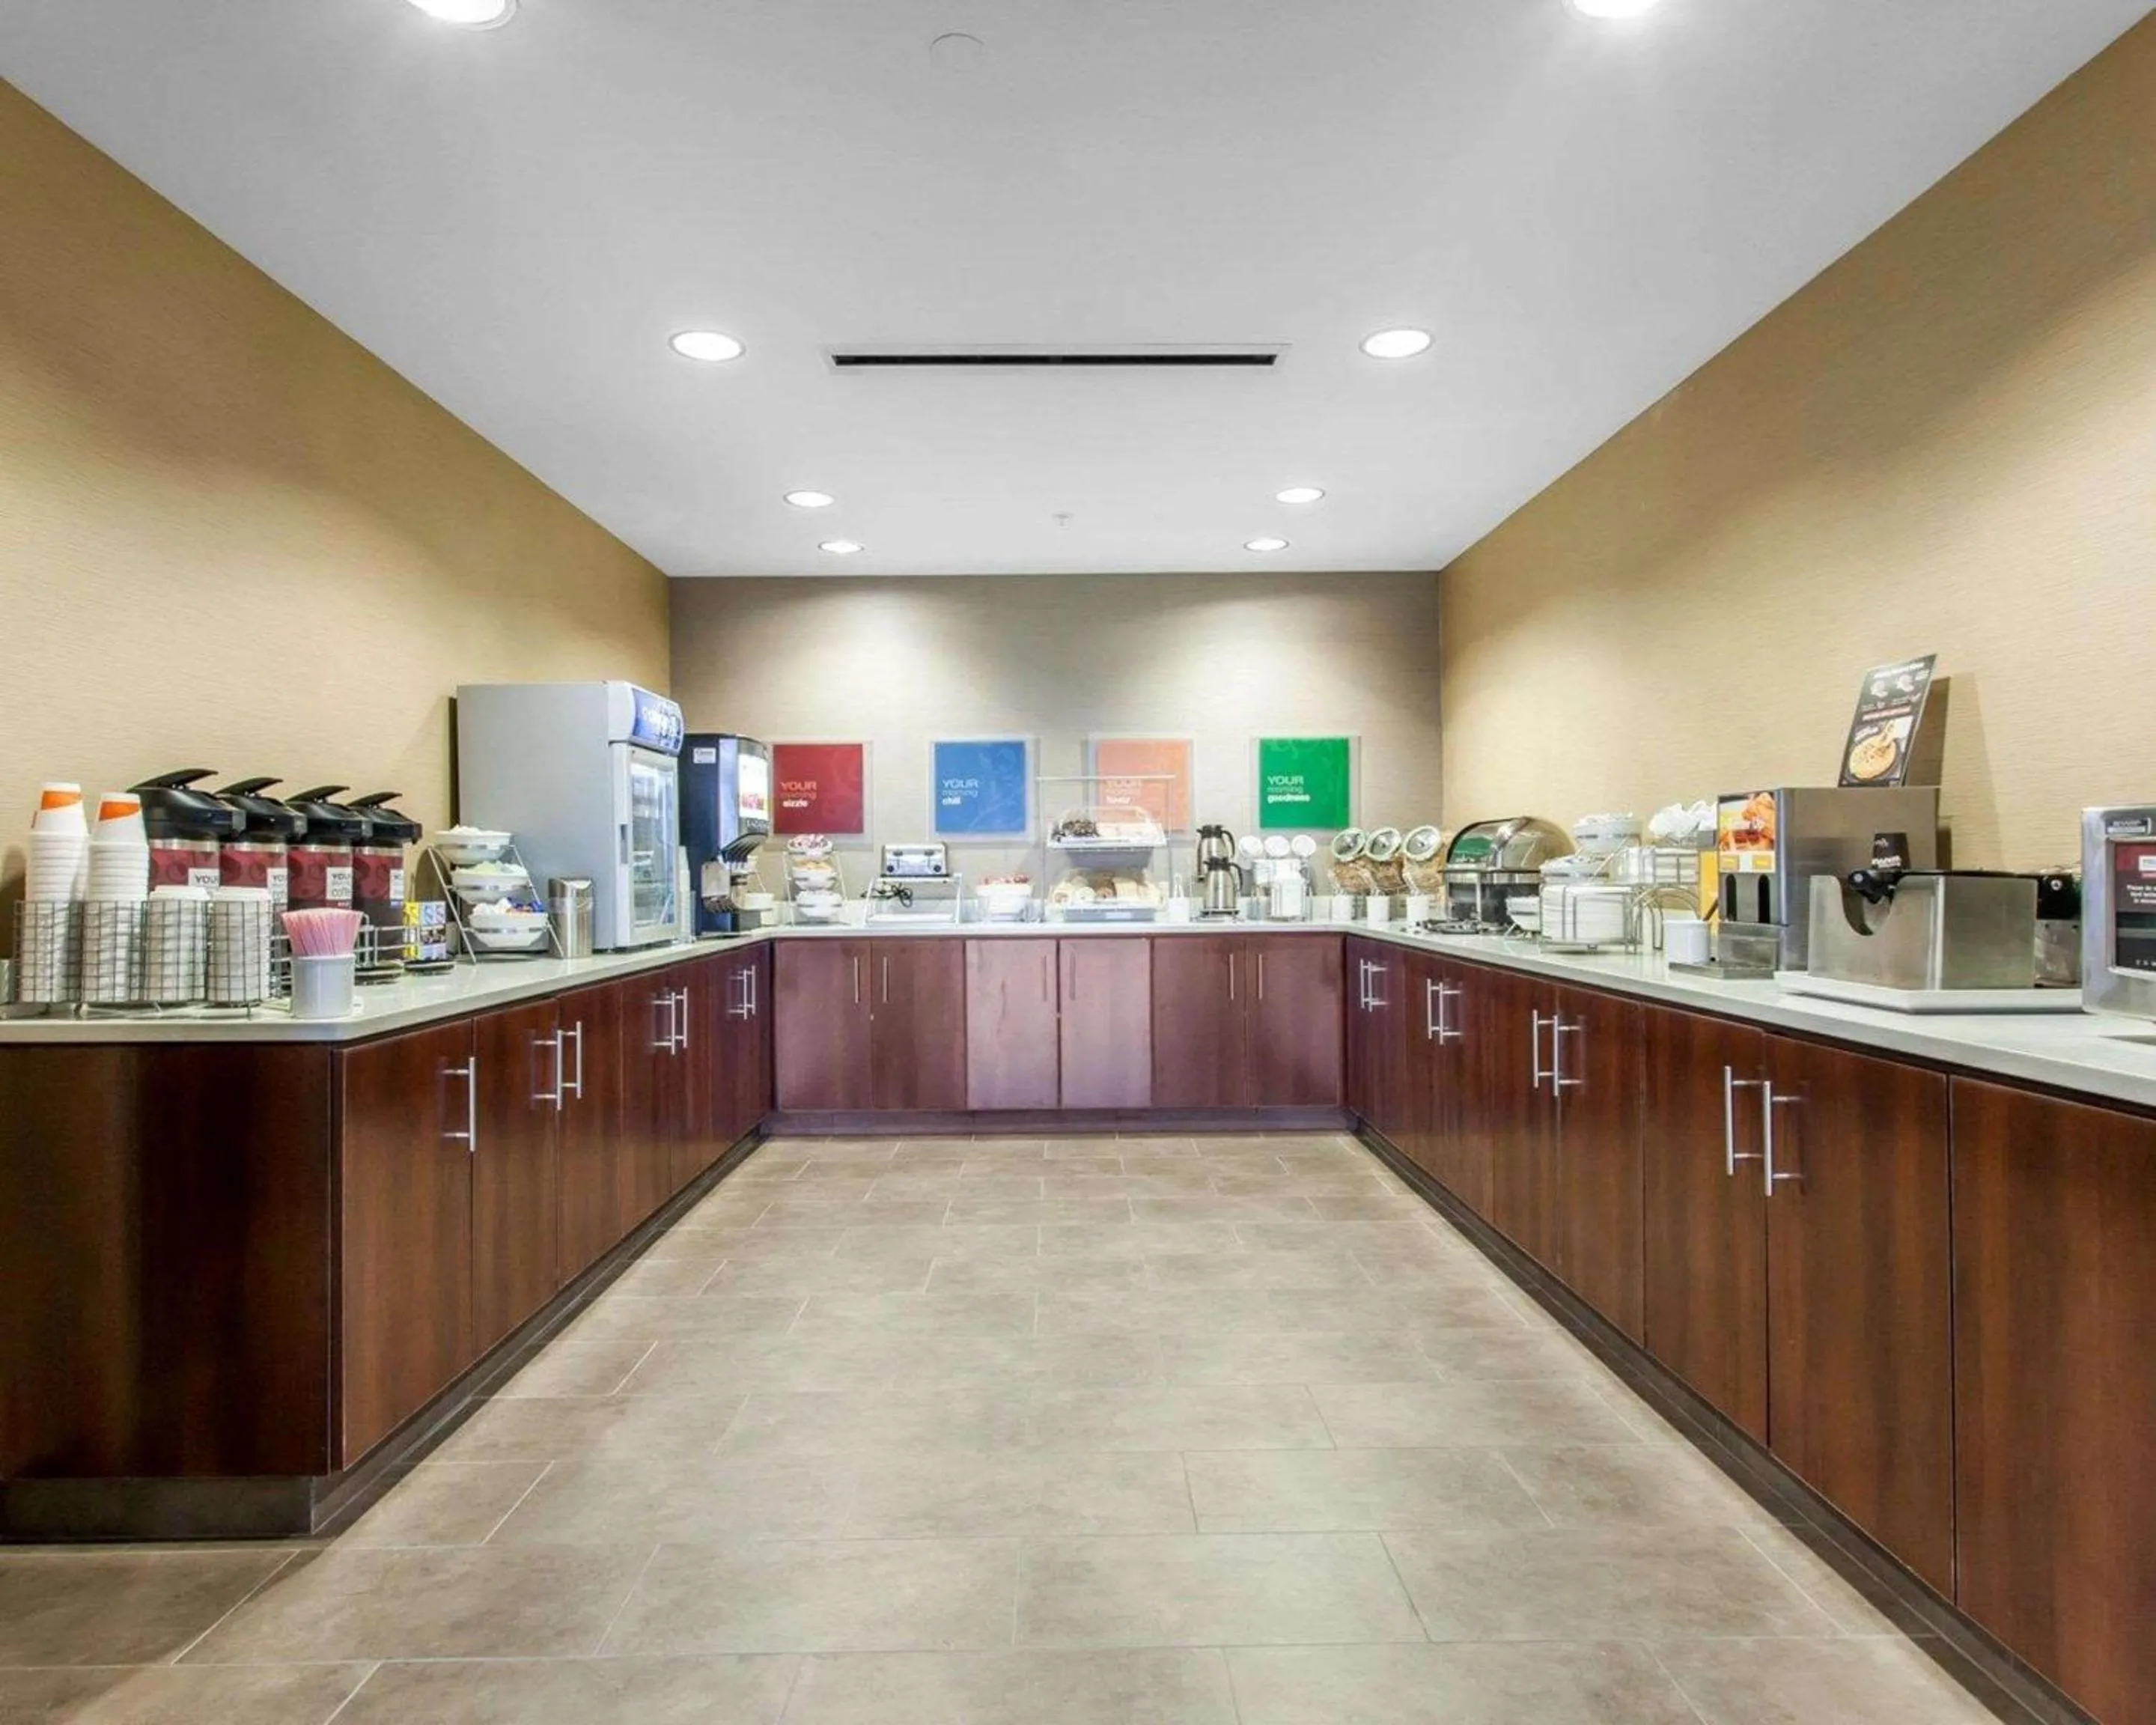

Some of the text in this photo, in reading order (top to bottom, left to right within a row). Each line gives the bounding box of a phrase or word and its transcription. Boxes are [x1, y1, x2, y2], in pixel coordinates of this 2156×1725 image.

[943, 779, 978, 788] YOUR
[1267, 776, 1303, 785] YOUR
[780, 781, 817, 791] YOUR
[1267, 794, 1310, 803] goodness
